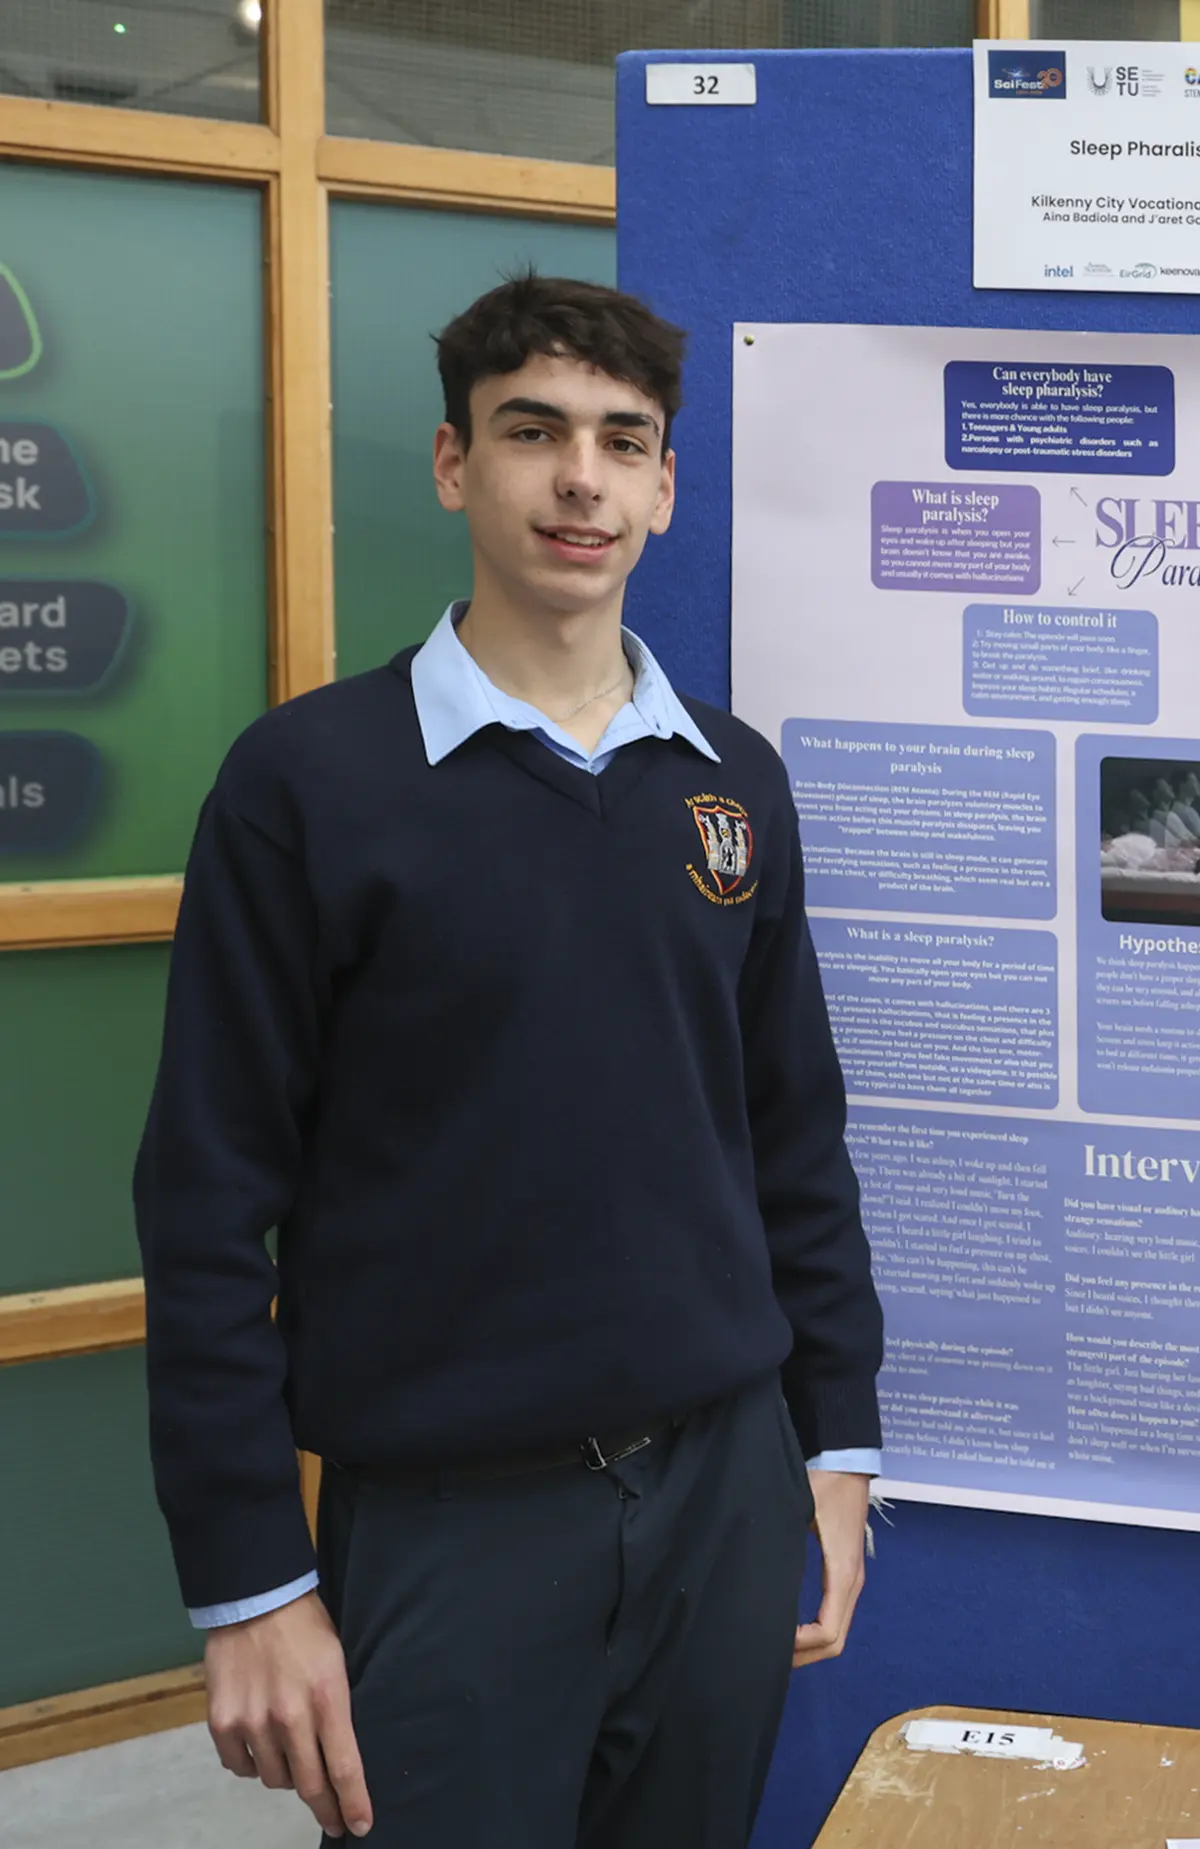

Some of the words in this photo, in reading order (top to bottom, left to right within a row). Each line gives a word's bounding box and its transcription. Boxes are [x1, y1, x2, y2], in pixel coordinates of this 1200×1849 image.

[1116, 66, 1138, 81] SE
[694, 76, 718, 94] 32
[1116, 82, 1139, 96] TU
[1070, 140, 1122, 159] Sleep
[1031, 195, 1092, 213] Kilkenny
[1095, 196, 1124, 213] City
[1042, 212, 1070, 222] Aina
[1072, 212, 1119, 223] Badiola
[1122, 214, 1145, 223] and
[1044, 264, 1074, 278] intel
[1160, 266, 1200, 277] keenova
[992, 367, 1017, 382] Can
[1019, 369, 1079, 386] everybody
[1083, 369, 1112, 384] have
[1002, 382, 1033, 398] sleep
[1036, 381, 1103, 399] pharalysis?
[912, 489, 946, 504] What
[951, 490, 962, 505] is
[964, 491, 999, 509] sleep
[922, 508, 989, 525] paralysis?
[1003, 609, 1033, 624] How
[1037, 612, 1051, 625] to
[1054, 613, 1103, 627] control
[1107, 613, 1116, 628] it
[800, 736, 831, 748] What
[834, 738, 882, 752] happens
[884, 742, 896, 751] to
[899, 744, 926, 755] your
[928, 743, 960, 755] brain
[963, 745, 1003, 759] during
[1005, 747, 1035, 761] sleep
[890, 762, 942, 775] paralysis
[0, 776, 46, 810] ls
[847, 927, 878, 939] What
[881, 930, 891, 940] is
[894, 933, 900, 941] a
[904, 931, 933, 945] sleep
[935, 934, 994, 947] paralysis?
[961, 1730, 1015, 1746] E15
